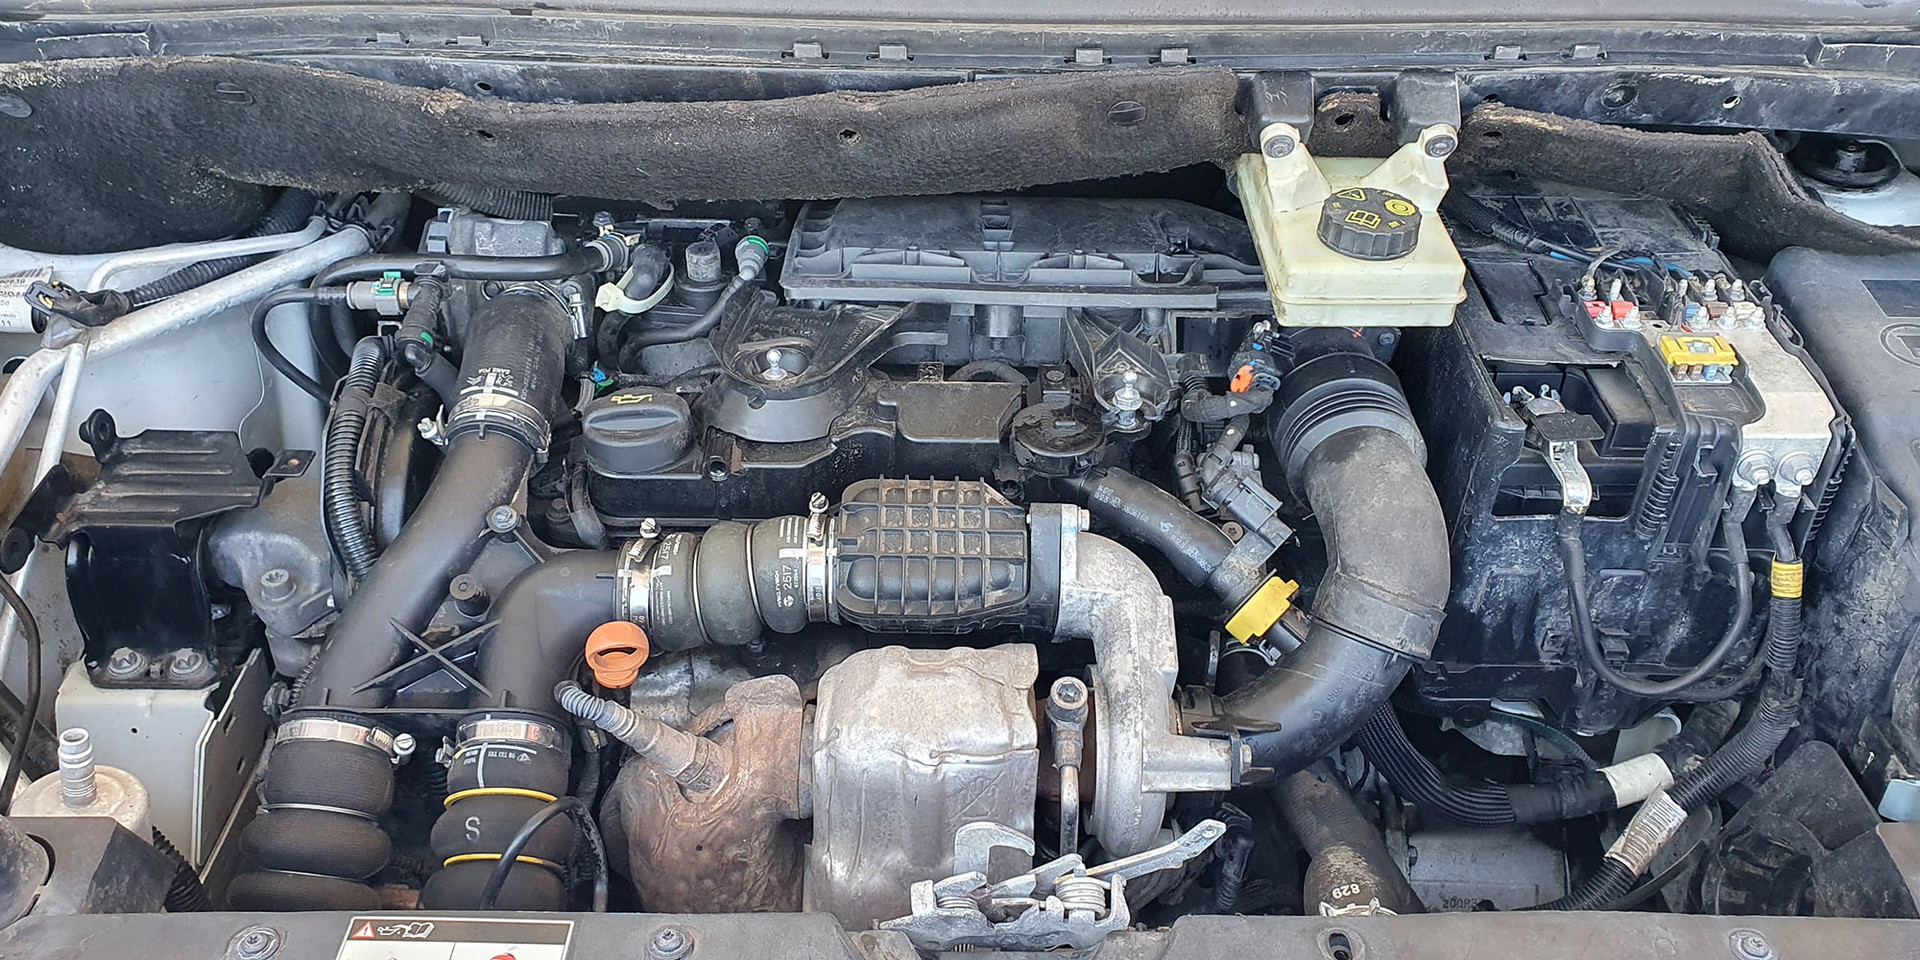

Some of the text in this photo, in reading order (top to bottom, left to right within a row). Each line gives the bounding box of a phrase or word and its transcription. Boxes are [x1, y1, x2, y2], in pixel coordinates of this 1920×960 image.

[782, 564, 793, 590] 2517
[465, 815, 481, 841] S
[1331, 883, 1361, 900] 829
